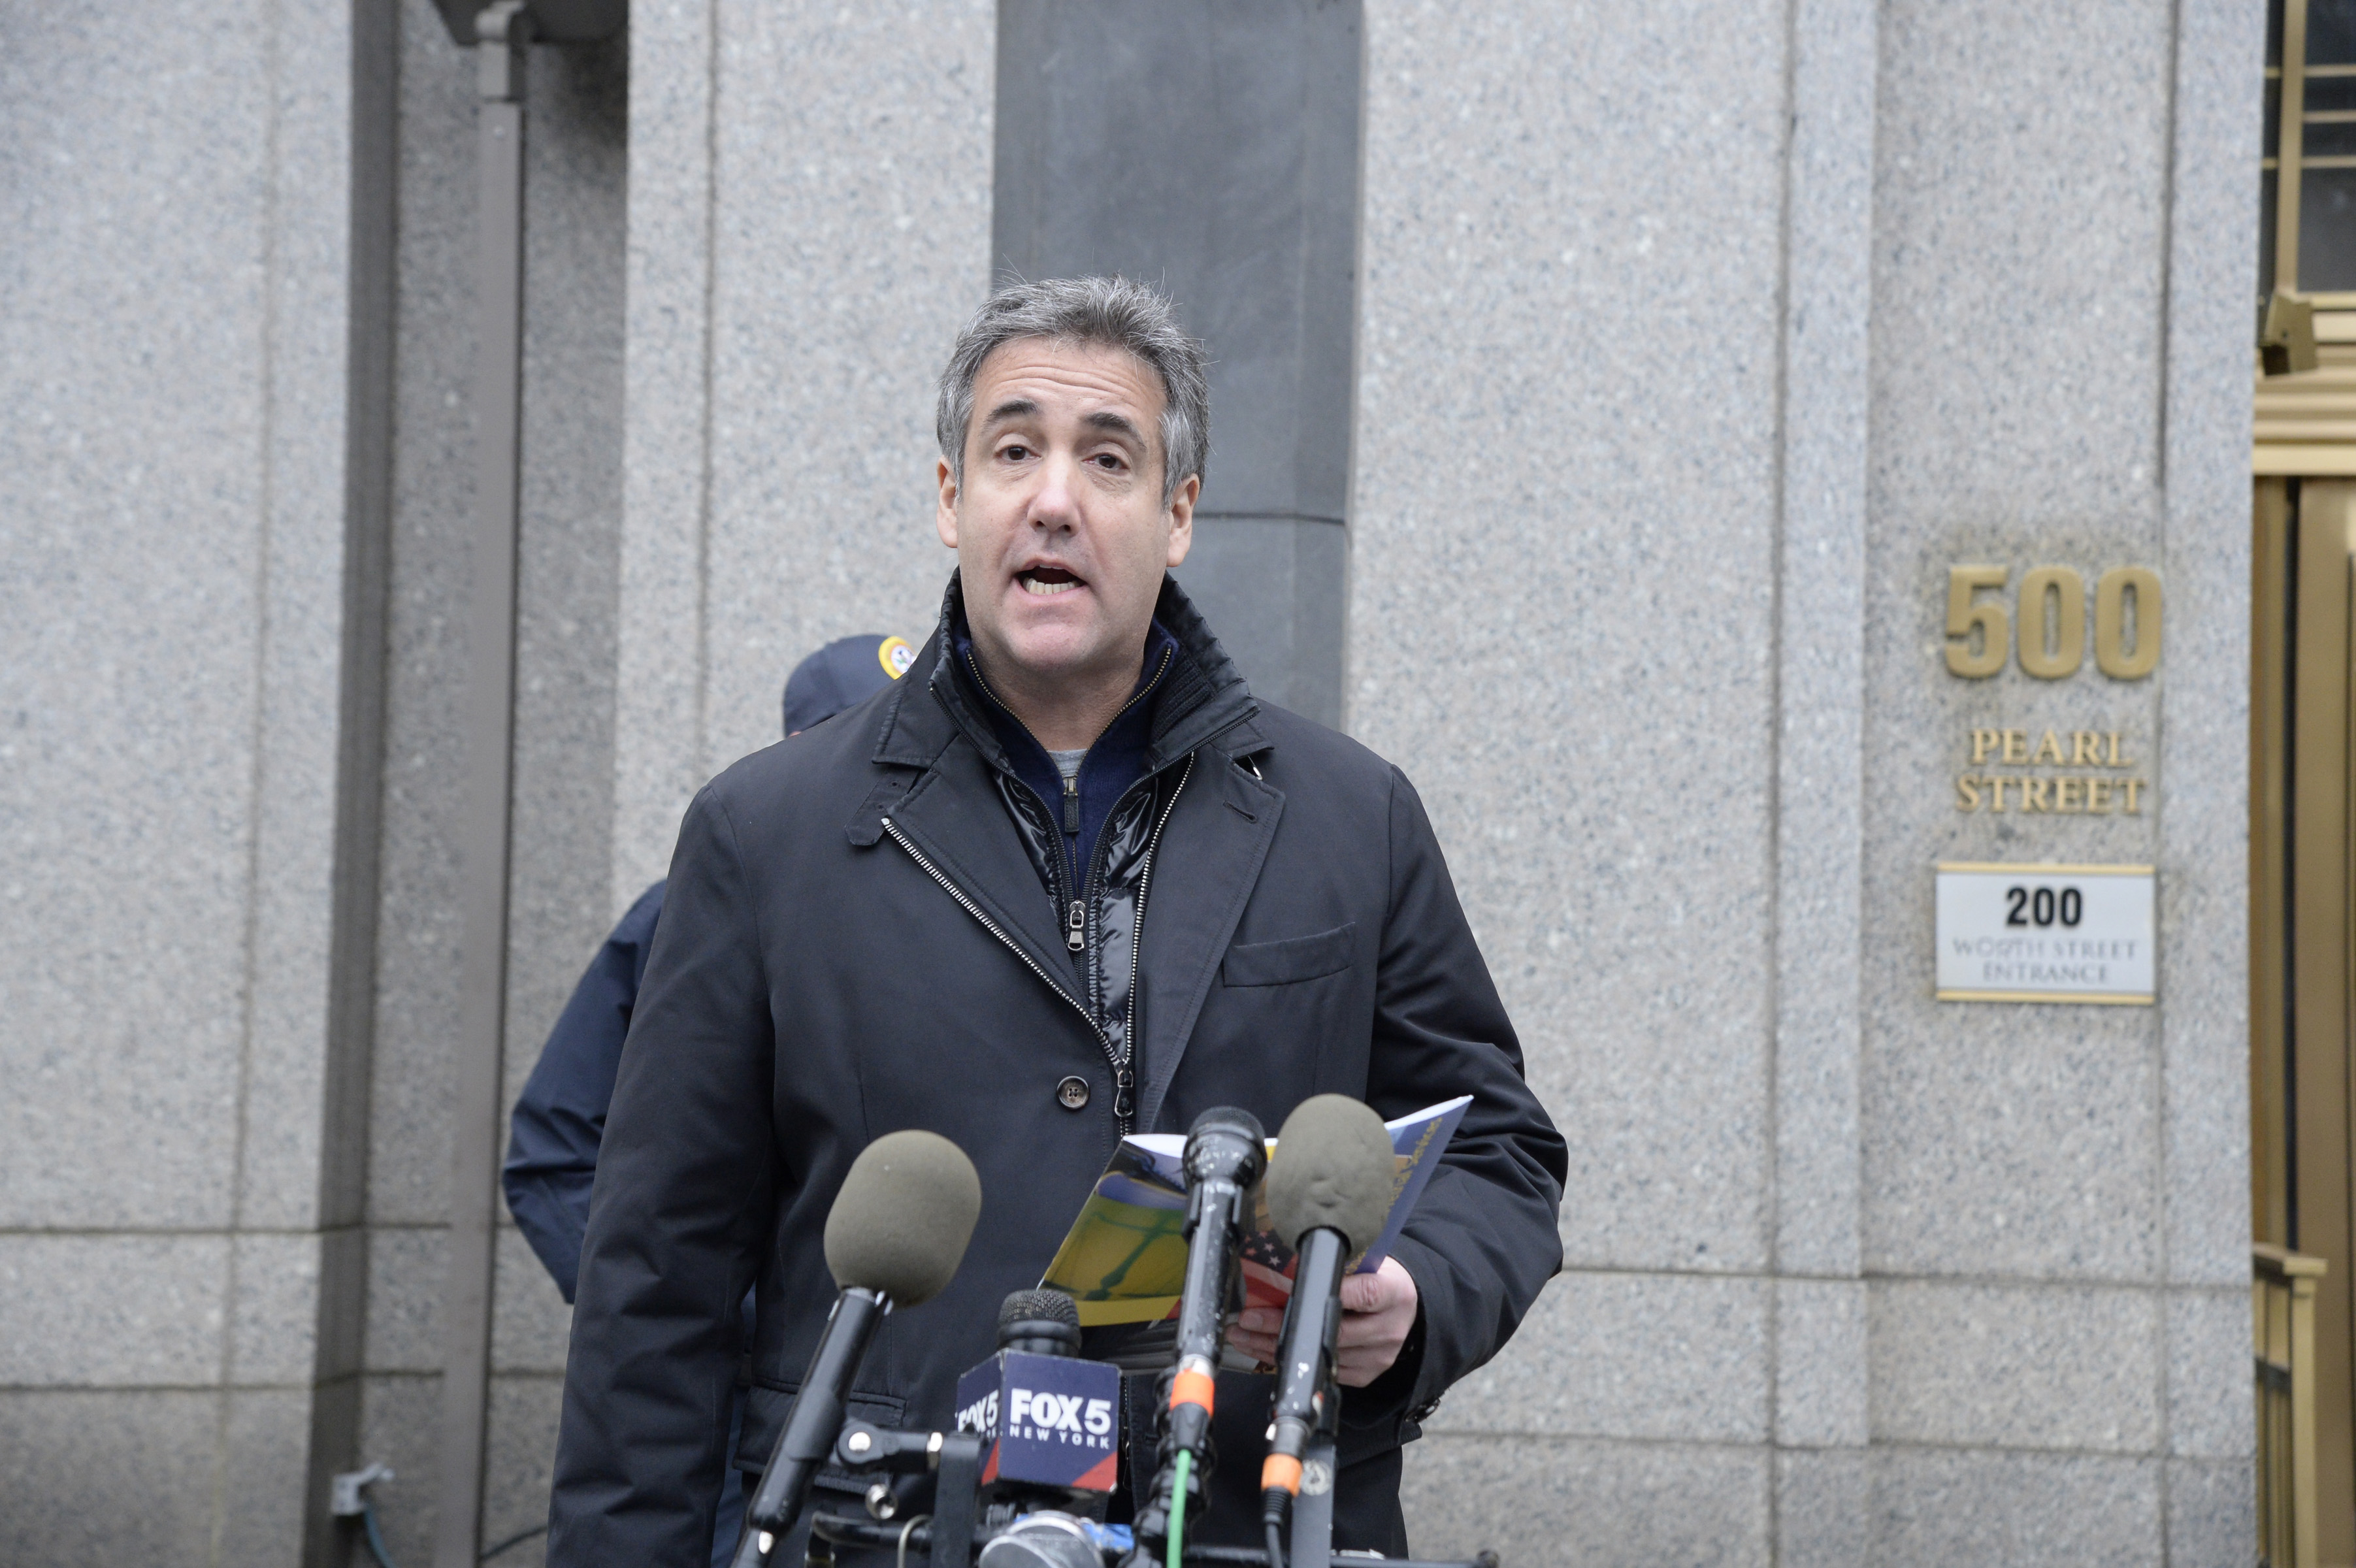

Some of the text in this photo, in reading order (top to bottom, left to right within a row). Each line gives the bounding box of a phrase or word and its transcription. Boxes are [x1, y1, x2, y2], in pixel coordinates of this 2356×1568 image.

[1945, 564, 2162, 680] 500
[1969, 728, 2133, 767] PEARL
[1955, 774, 2146, 813] STREET
[2006, 886, 2082, 928] 200
[1953, 936, 2136, 960] WORTH STREET
[1982, 960, 2108, 984] ENTRANCE
[1010, 1388, 1111, 1435] FOX 5
[1009, 1424, 1050, 1442] NEW
[1058, 1430, 1109, 1450] YORK
